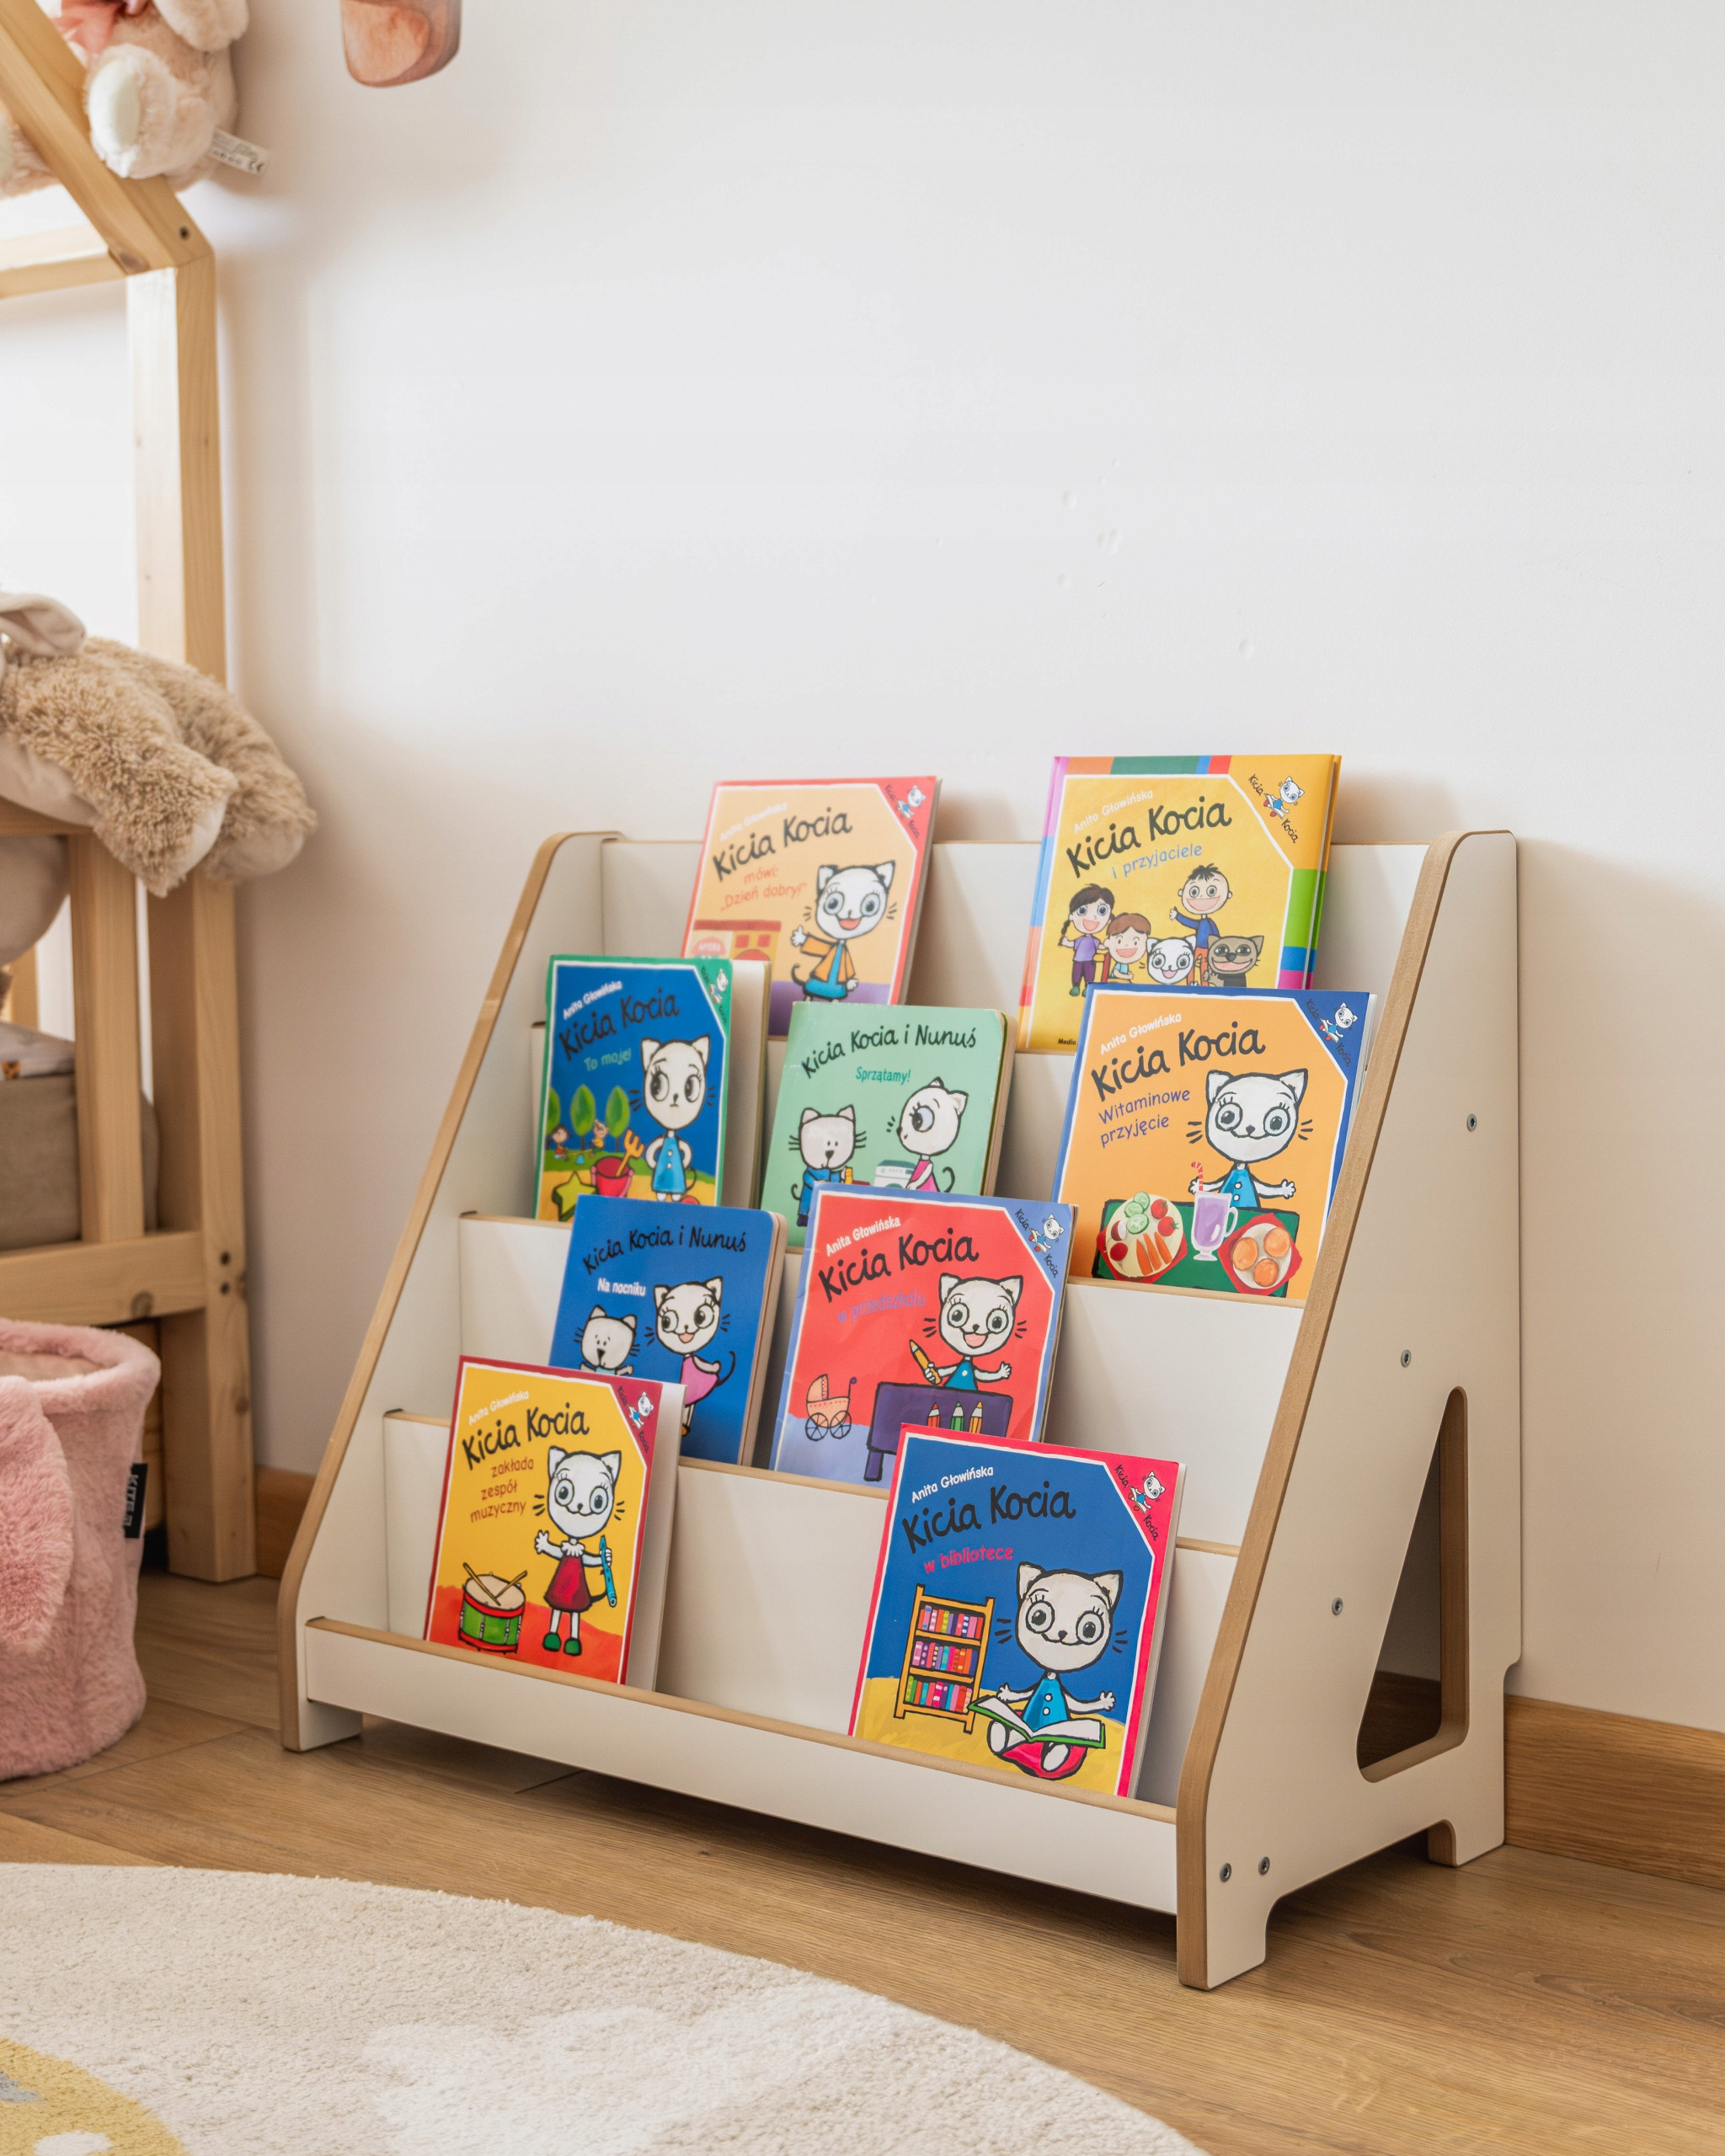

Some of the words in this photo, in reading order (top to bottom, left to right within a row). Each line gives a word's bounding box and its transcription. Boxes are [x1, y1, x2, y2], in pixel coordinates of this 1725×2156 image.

[1074, 811, 1099, 834] Anita
[1102, 788, 1153, 816] Głowińska
[1248, 774, 1263, 796] Kicia
[1281, 819, 1299, 844] Kocia
[713, 832, 776, 882] Kicia
[782, 807, 853, 847] Kocia
[1065, 824, 1141, 879] Kicia
[1148, 796, 1232, 841] Kocia
[744, 865, 778, 884] mówi:
[1112, 867, 1118, 879] i
[1123, 843, 1203, 878] przyjaciele
[563, 1002, 584, 1021] Anita
[583, 980, 622, 1005] Głowińska
[558, 1011, 617, 1062] Kicia
[620, 988, 681, 1029] Kocia
[1100, 1034, 1127, 1055] Anita
[1129, 1013, 1182, 1038] Głowińska
[584, 1057, 598, 1071] To
[800, 1042, 846, 1079] Kicia
[851, 1025, 899, 1052] Kocia
[904, 1023, 911, 1045] i
[915, 1024, 977, 1049] Nunuś
[1091, 1045, 1171, 1102] Kicia
[1178, 1021, 1266, 1066] Kocia
[856, 1066, 911, 1086] Sprzątamy!
[1098, 1089, 1191, 1124] Witaminowe
[1100, 1115, 1169, 1148] przyjęcie
[582, 1239, 623, 1276] Kicia
[629, 1225, 674, 1251] Kocia
[679, 1225, 685, 1246] i
[688, 1226, 746, 1251] Nunuś
[825, 1235, 852, 1257] Anita
[852, 1216, 900, 1241] Głowińska
[1015, 1209, 1029, 1230] Kicia
[1044, 1254, 1059, 1278] Kocia
[818, 1248, 891, 1303] Kicia
[898, 1227, 980, 1271] Kocia
[597, 1278, 610, 1292] Na
[612, 1282, 646, 1296] nocniku
[836, 1311, 846, 1324] w
[851, 1289, 926, 1321] przedszkolu
[467, 1407, 489, 1426] Anita
[489, 1390, 529, 1412] Głowińska
[462, 1419, 521, 1470] Kicia
[526, 1402, 590, 1442] Kocia
[491, 1456, 534, 1478] zakłada
[911, 1482, 938, 1503] Anita
[940, 1465, 994, 1488] Głowińska
[470, 1499, 526, 1523] muzyczny
[481, 1481, 518, 1501] zespół
[1115, 1464, 1129, 1488] Kicia
[1144, 1515, 1158, 1541] Kocia
[902, 1497, 982, 1554] Kicia
[990, 1481, 1076, 1524] Kocia
[923, 1561, 935, 1574] w
[940, 1545, 1013, 1569] bibliotece
